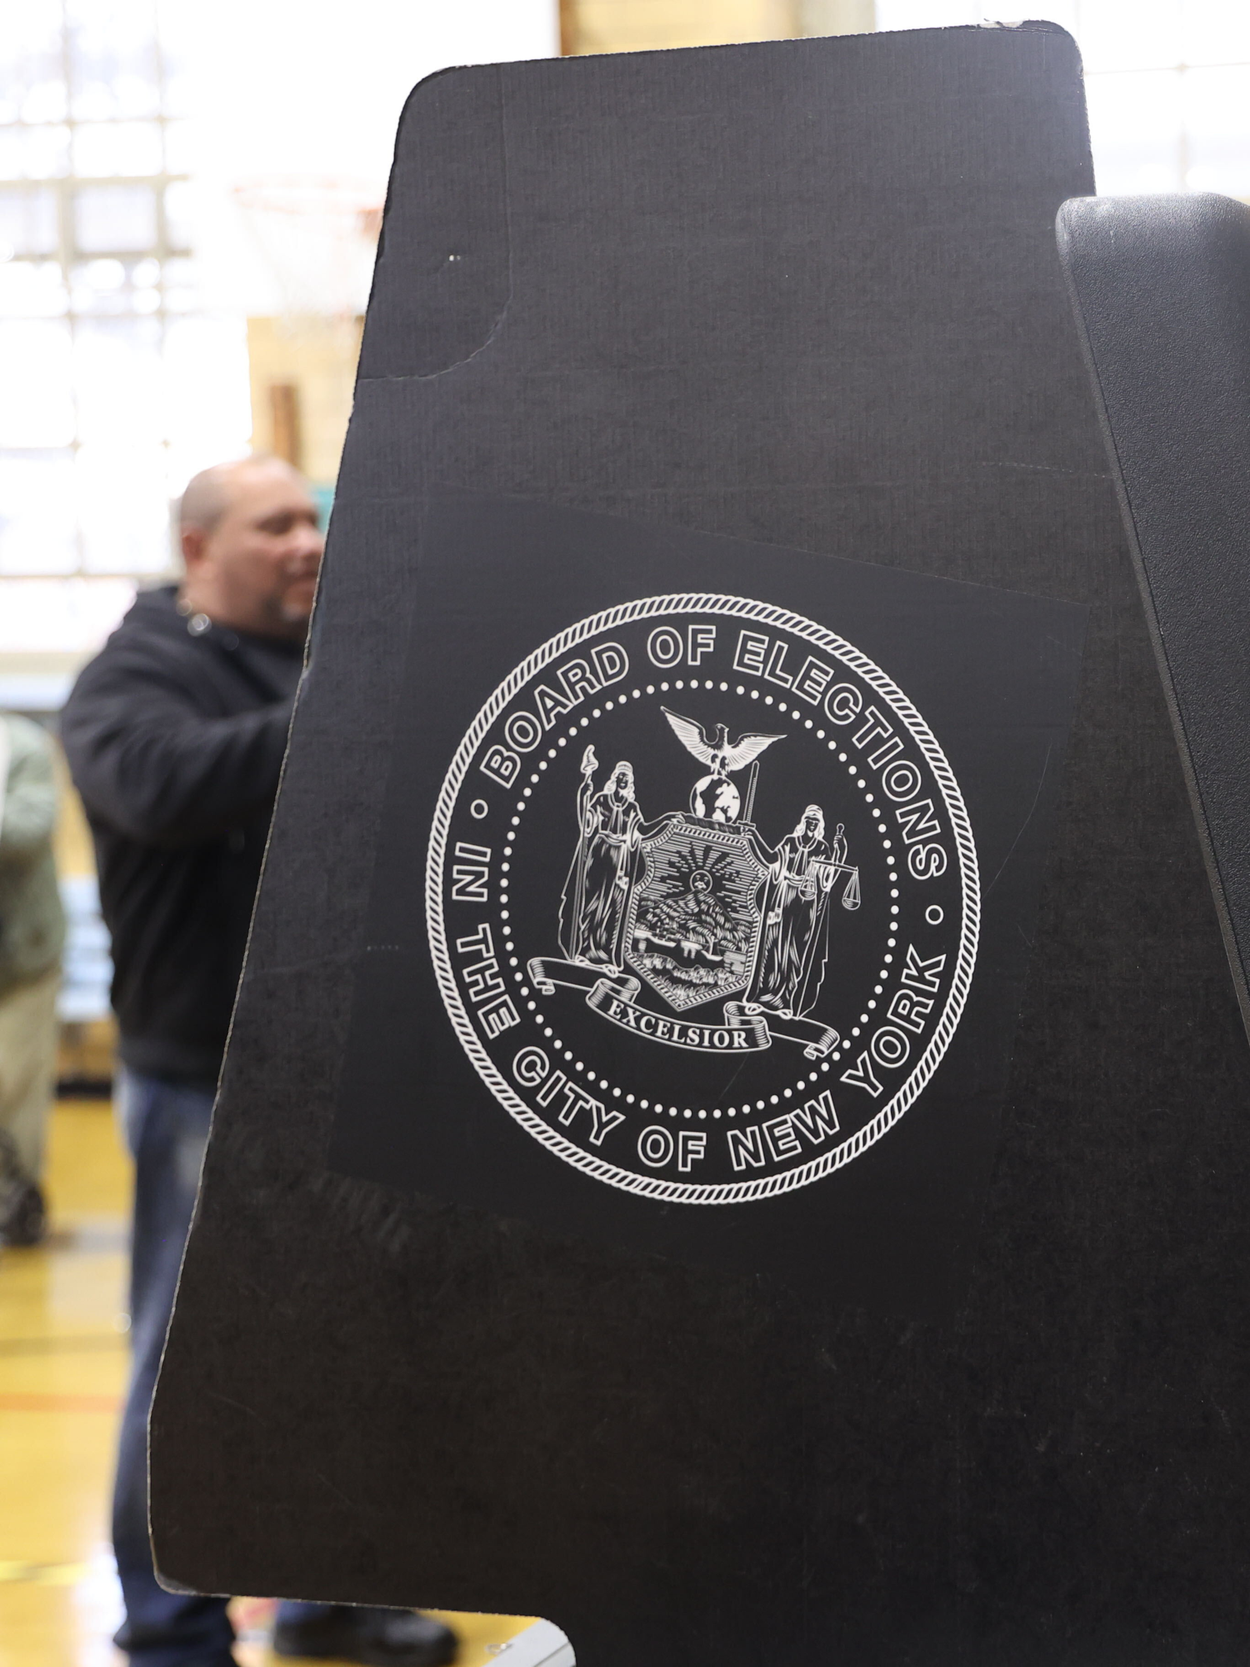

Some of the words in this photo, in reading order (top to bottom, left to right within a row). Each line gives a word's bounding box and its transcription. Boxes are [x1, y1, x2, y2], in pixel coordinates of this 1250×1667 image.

[479, 641, 630, 790] BOARD
[646, 624, 717, 669] OF
[732, 629, 948, 881] ELECTIONS
[451, 841, 492, 903] IN
[455, 922, 521, 1040] THE
[606, 998, 750, 1049] EXCELSIOR
[839, 943, 947, 1098] YORK
[512, 1045, 627, 1147] CITY
[726, 1089, 841, 1172] NEW
[637, 1125, 707, 1173] OF
